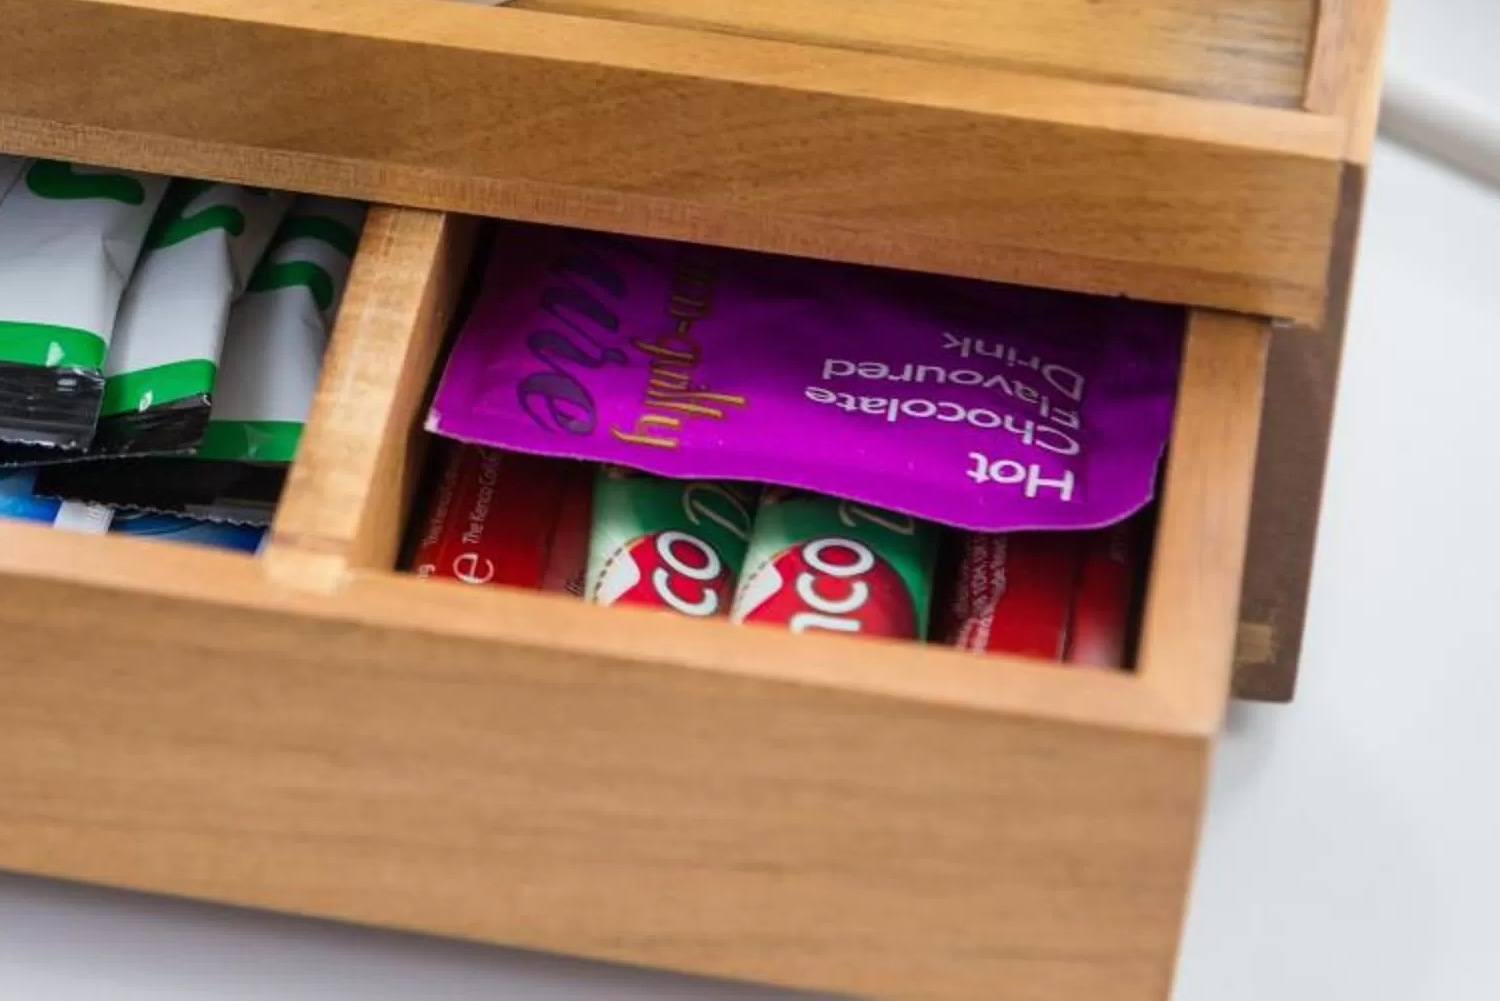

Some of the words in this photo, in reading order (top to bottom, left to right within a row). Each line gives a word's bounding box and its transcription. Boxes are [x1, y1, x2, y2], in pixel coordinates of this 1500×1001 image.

[821, 358, 1081, 430] Flavoured
[940, 330, 1085, 403] Drink
[804, 386, 1080, 456] Chocolate
[965, 451, 1075, 503] Hot
